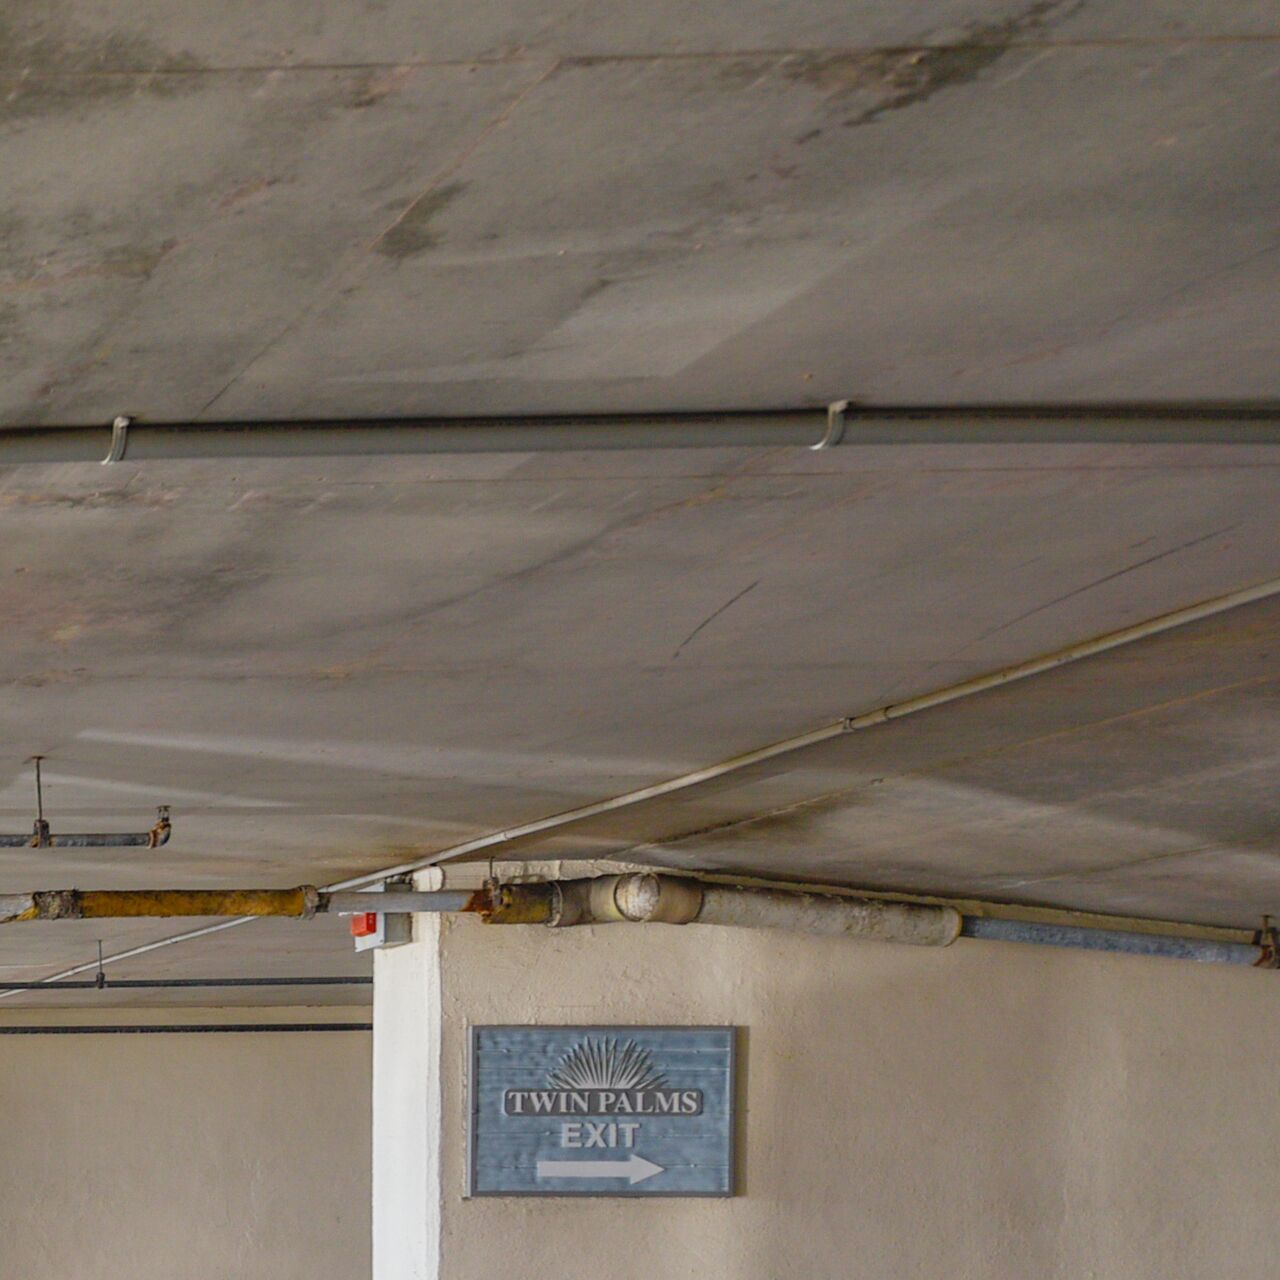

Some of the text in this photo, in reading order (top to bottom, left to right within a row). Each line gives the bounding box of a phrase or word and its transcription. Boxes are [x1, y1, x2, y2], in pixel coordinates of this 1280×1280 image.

[507, 1091, 699, 1114] TWIN PALMS
[560, 1122, 640, 1148] EXIT
